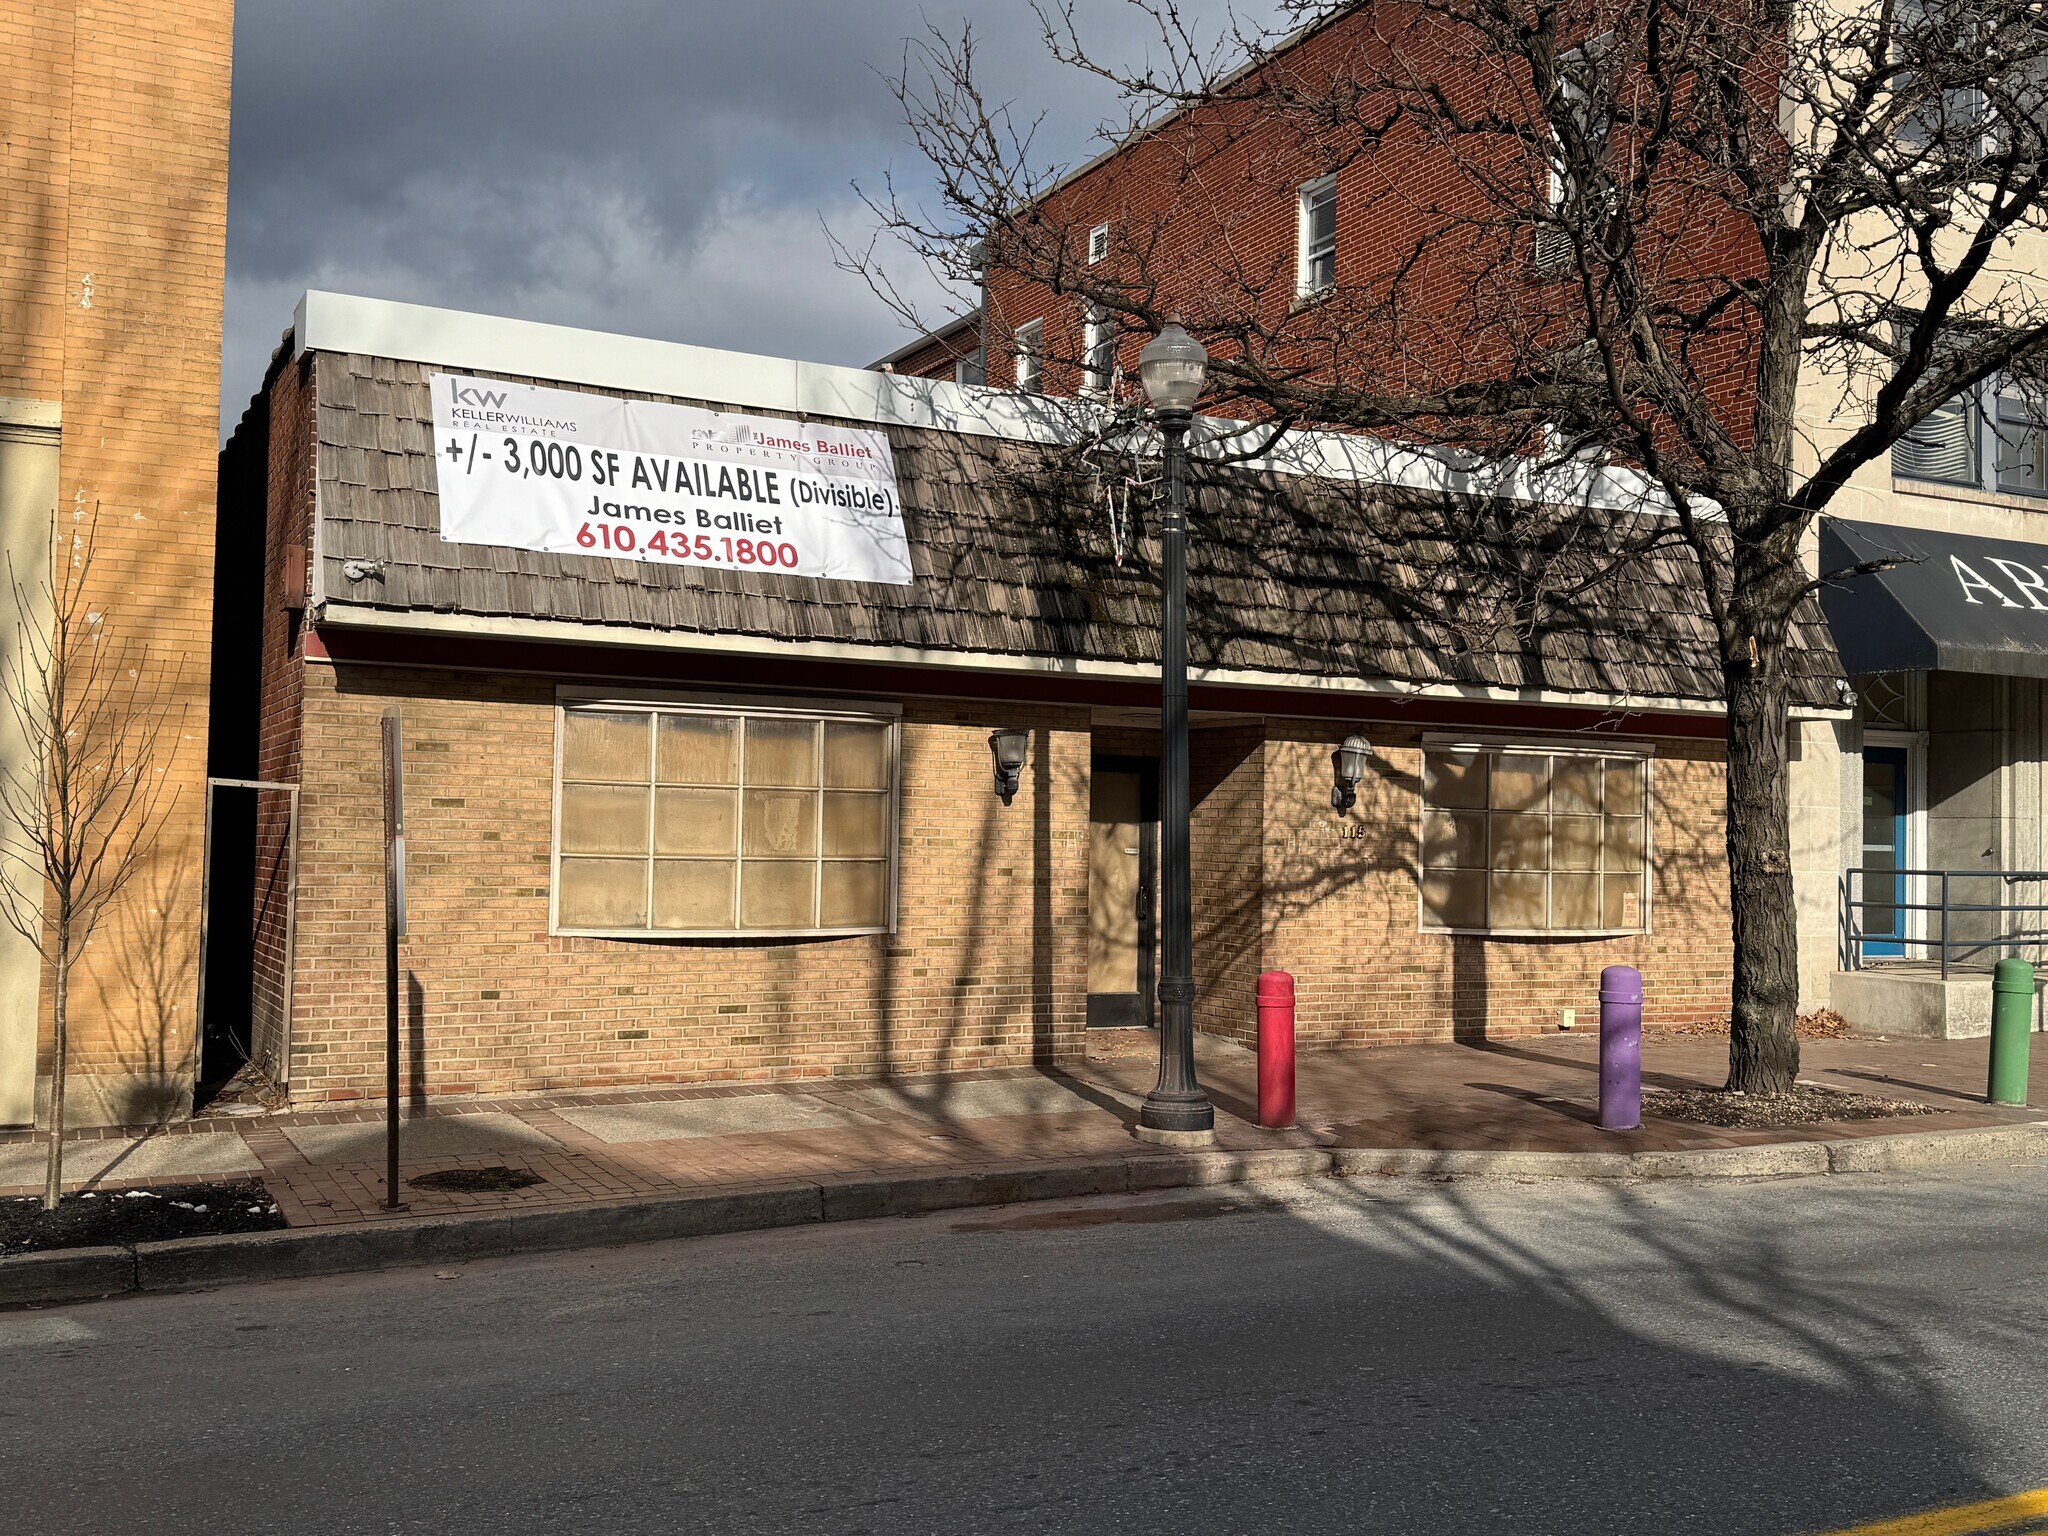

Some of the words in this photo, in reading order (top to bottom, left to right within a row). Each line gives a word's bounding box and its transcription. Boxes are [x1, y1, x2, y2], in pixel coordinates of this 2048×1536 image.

[453, 420, 491, 431] REAL
[502, 424, 557, 437] ESTATE
[756, 432, 811, 452] James
[816, 440, 873, 459] Balliet
[692, 442, 797, 461] PROPERTY
[813, 457, 877, 471] GROUP
[446, 433, 492, 475] +/-
[503, 437, 582, 482] 3,000
[590, 449, 620, 487] SF
[631, 455, 781, 505] AVAILABLE
[790, 478, 893, 518] (Divisible)
[588, 495, 686, 526] James
[696, 508, 783, 535] Balliet
[576, 522, 799, 568] 610.435.1800
[1949, 554, 2048, 611] AR
[1342, 825, 1366, 839] 115
